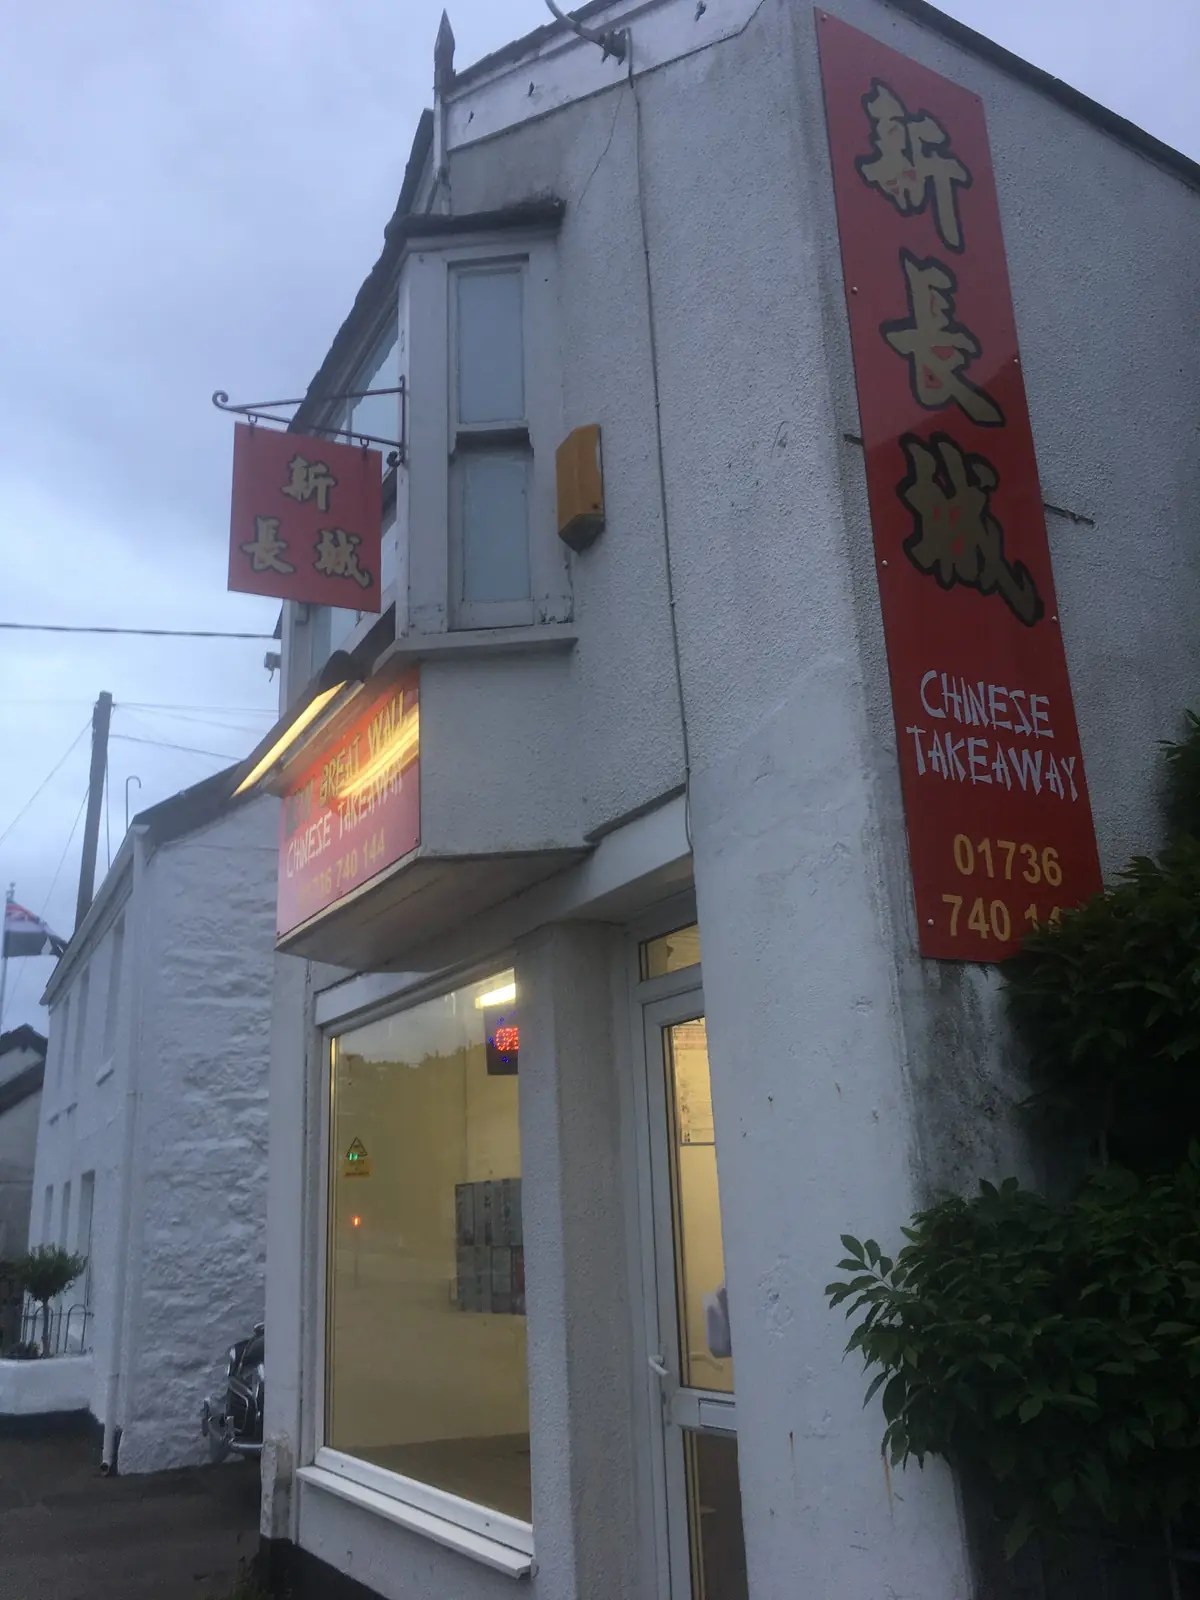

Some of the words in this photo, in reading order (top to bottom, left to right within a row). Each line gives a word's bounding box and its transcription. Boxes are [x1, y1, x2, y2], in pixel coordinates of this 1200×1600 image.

[855, 77, 1044, 627] 新長城
[281, 453, 338, 513] 新
[920, 669, 1055, 738] CHINESE
[906, 725, 1078, 802] TAKEAWAY
[286, 810, 332, 878] CHINESE
[336, 846, 358, 889] 740
[363, 826, 386, 869] 144
[953, 833, 1063, 887] 01736
[942, 894, 1012, 942] 740
